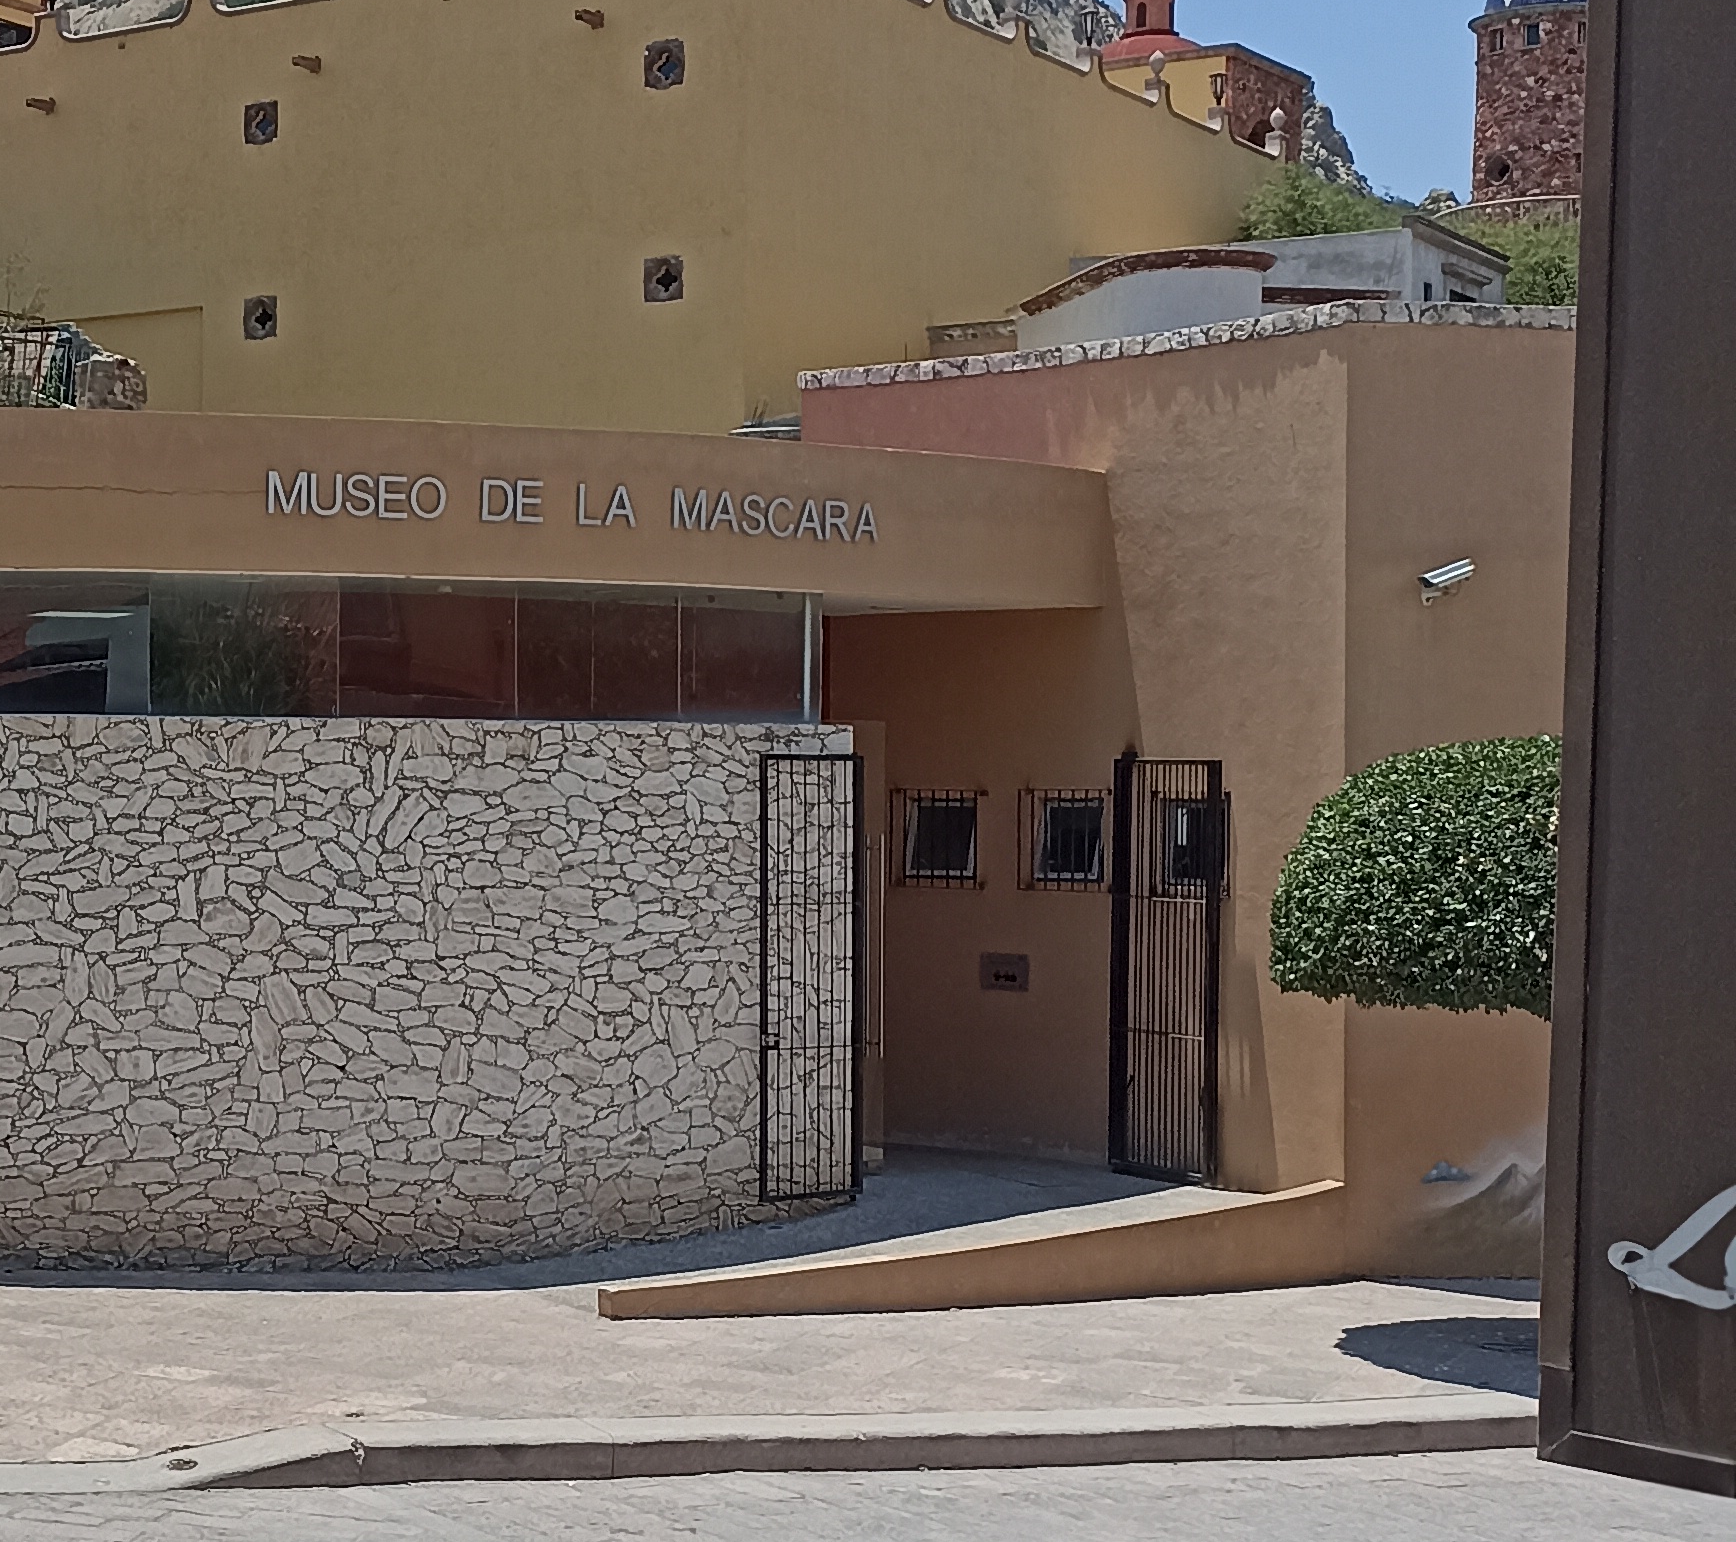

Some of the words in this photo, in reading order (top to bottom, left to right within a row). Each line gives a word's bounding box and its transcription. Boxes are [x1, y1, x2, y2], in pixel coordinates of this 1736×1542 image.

[267, 470, 447, 519] MUSEO
[481, 478, 544, 523] DE
[578, 483, 636, 527] LA
[672, 487, 879, 542] MASCARA
